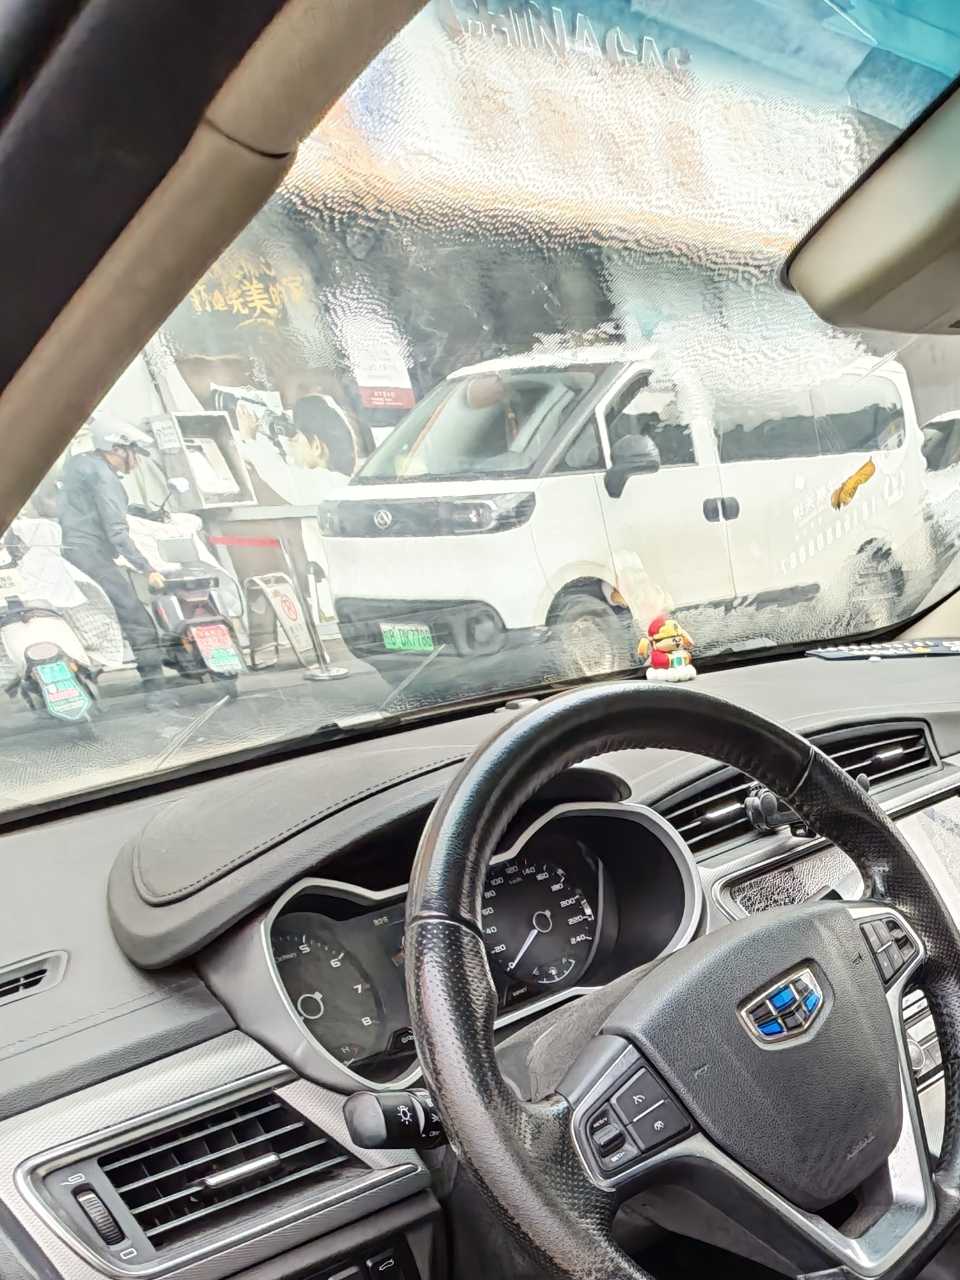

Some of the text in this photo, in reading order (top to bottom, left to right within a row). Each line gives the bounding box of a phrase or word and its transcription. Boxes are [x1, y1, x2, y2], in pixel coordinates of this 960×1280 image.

[298, 943, 310, 954] 5
[329, 958, 341, 968] 6
[352, 983, 362, 994] 7
[361, 1016, 372, 1026] 8
